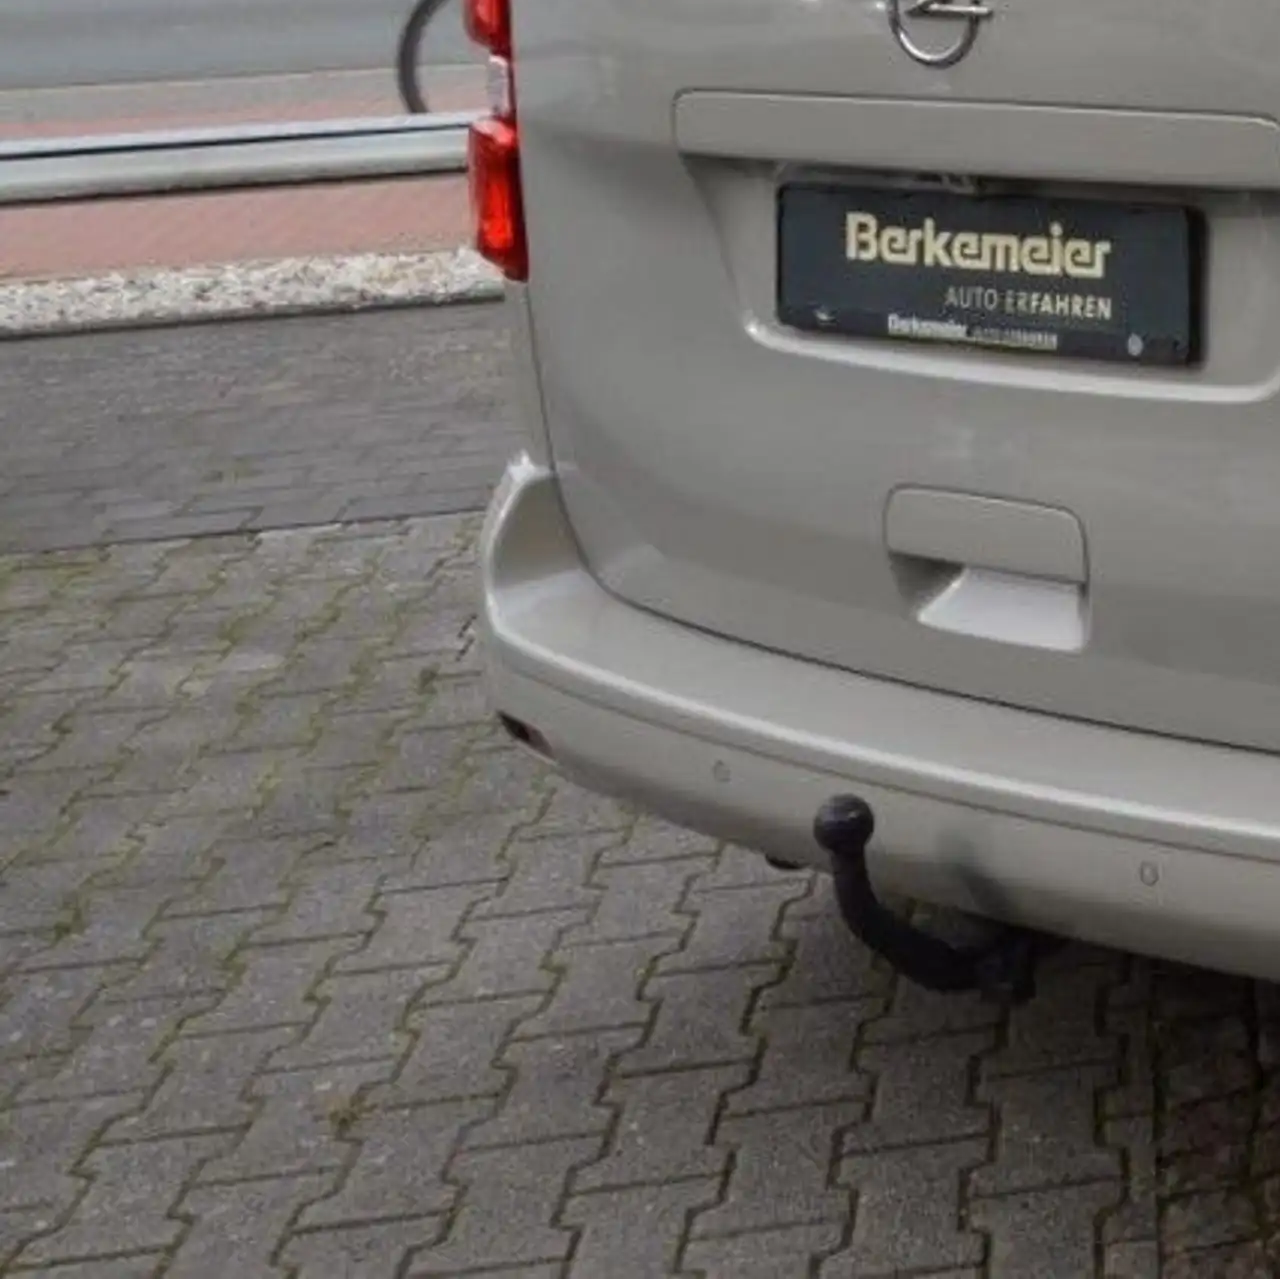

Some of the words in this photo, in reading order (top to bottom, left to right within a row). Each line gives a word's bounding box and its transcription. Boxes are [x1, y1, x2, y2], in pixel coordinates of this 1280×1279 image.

[845, 212, 1111, 279] Berkemeier
[944, 284, 998, 311] AUTO
[1004, 289, 1112, 320] ERFAHREN
